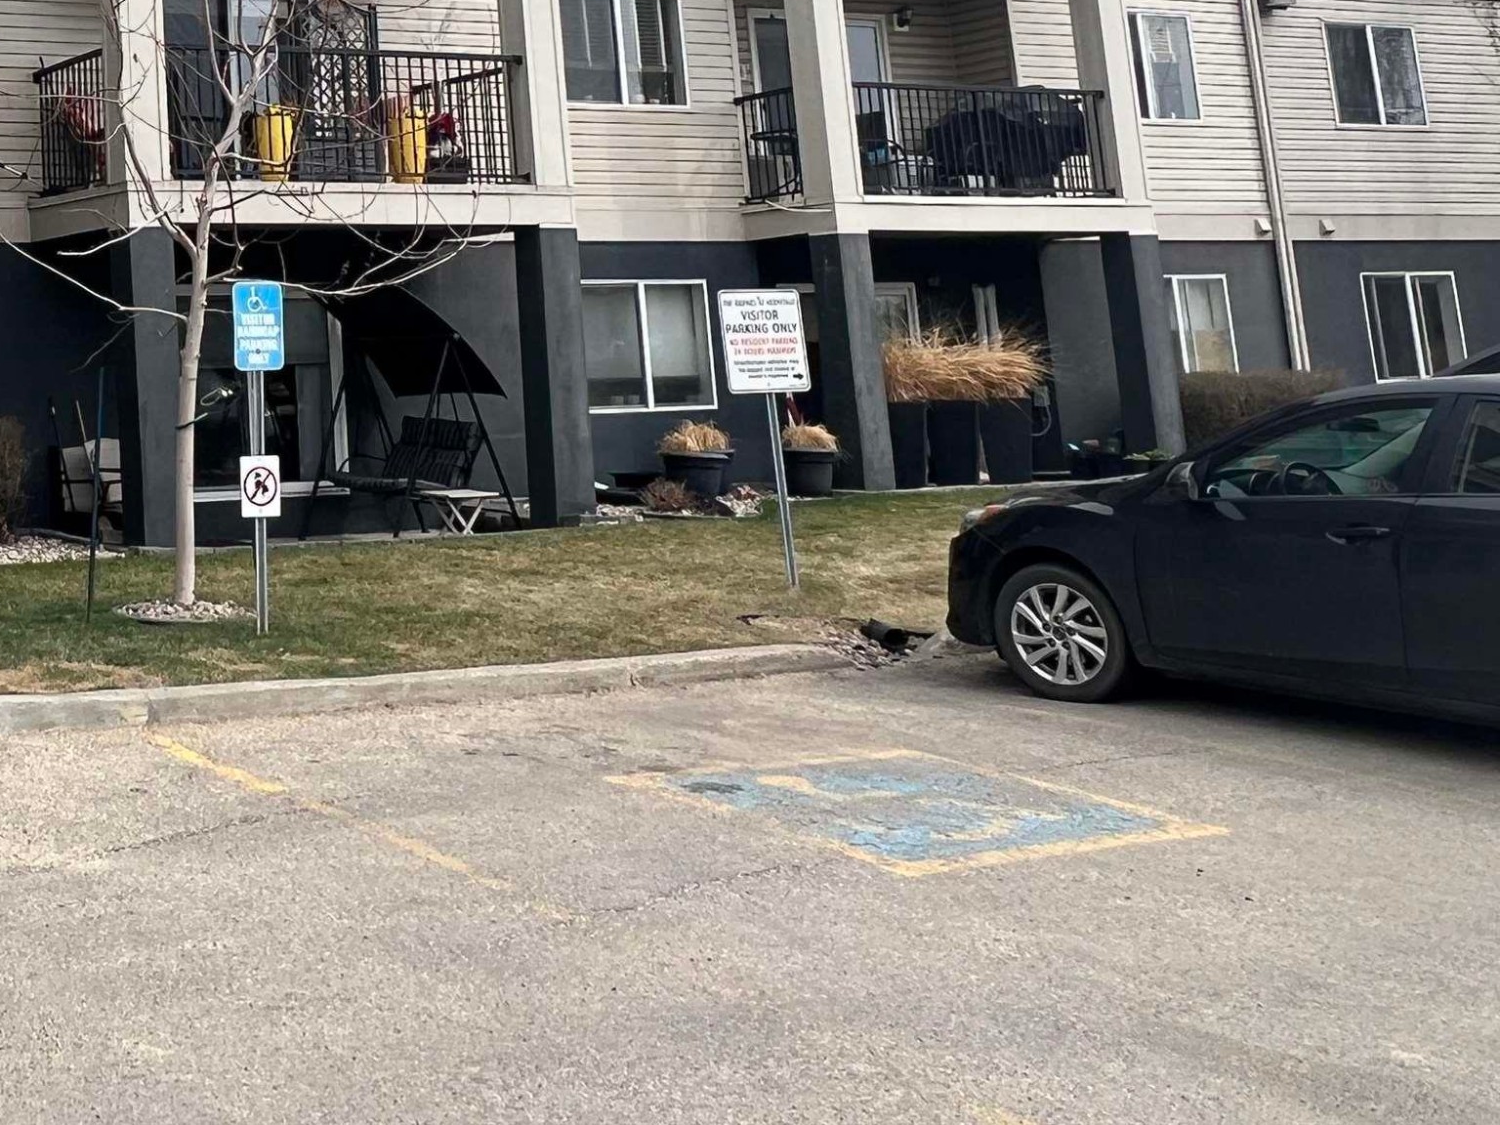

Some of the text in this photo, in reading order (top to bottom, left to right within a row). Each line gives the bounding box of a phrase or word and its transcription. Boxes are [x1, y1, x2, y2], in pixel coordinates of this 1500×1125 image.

[740, 310, 779, 321] VISITOR
[725, 323, 797, 334] PARKING ONLY
